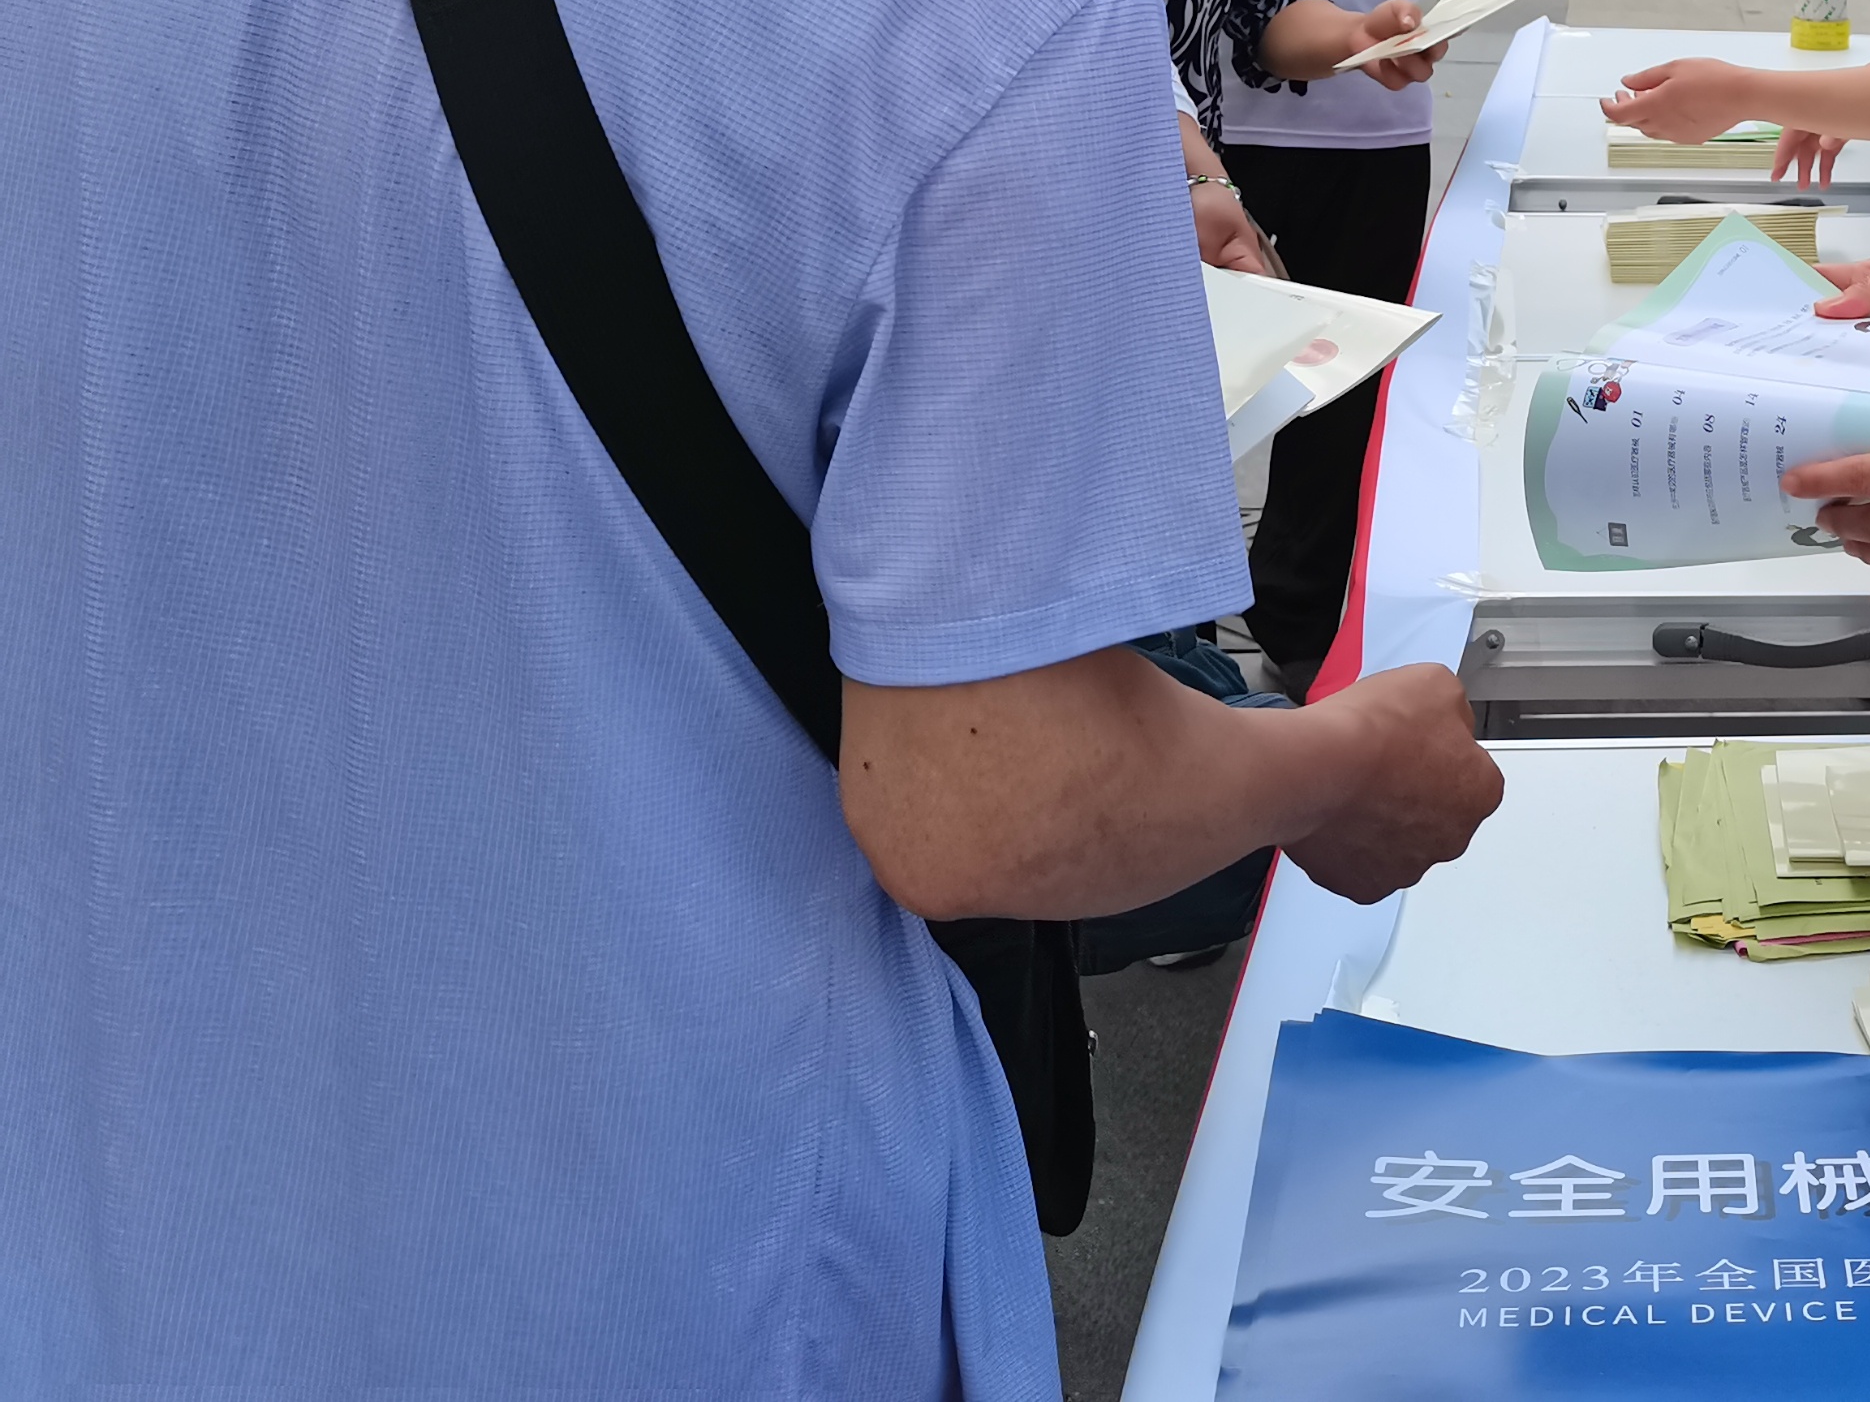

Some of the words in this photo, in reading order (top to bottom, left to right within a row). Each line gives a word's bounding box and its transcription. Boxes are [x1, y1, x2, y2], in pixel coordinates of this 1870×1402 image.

[1671, 389, 1686, 406] 04
[1744, 392, 1759, 407] 14
[1630, 410, 1643, 429] 01
[1702, 414, 1716, 434] 08
[1774, 414, 1788, 436] 24
[1458, 1304, 1666, 1329] MEDICAL
[1691, 1300, 1857, 1325] DEVICE
